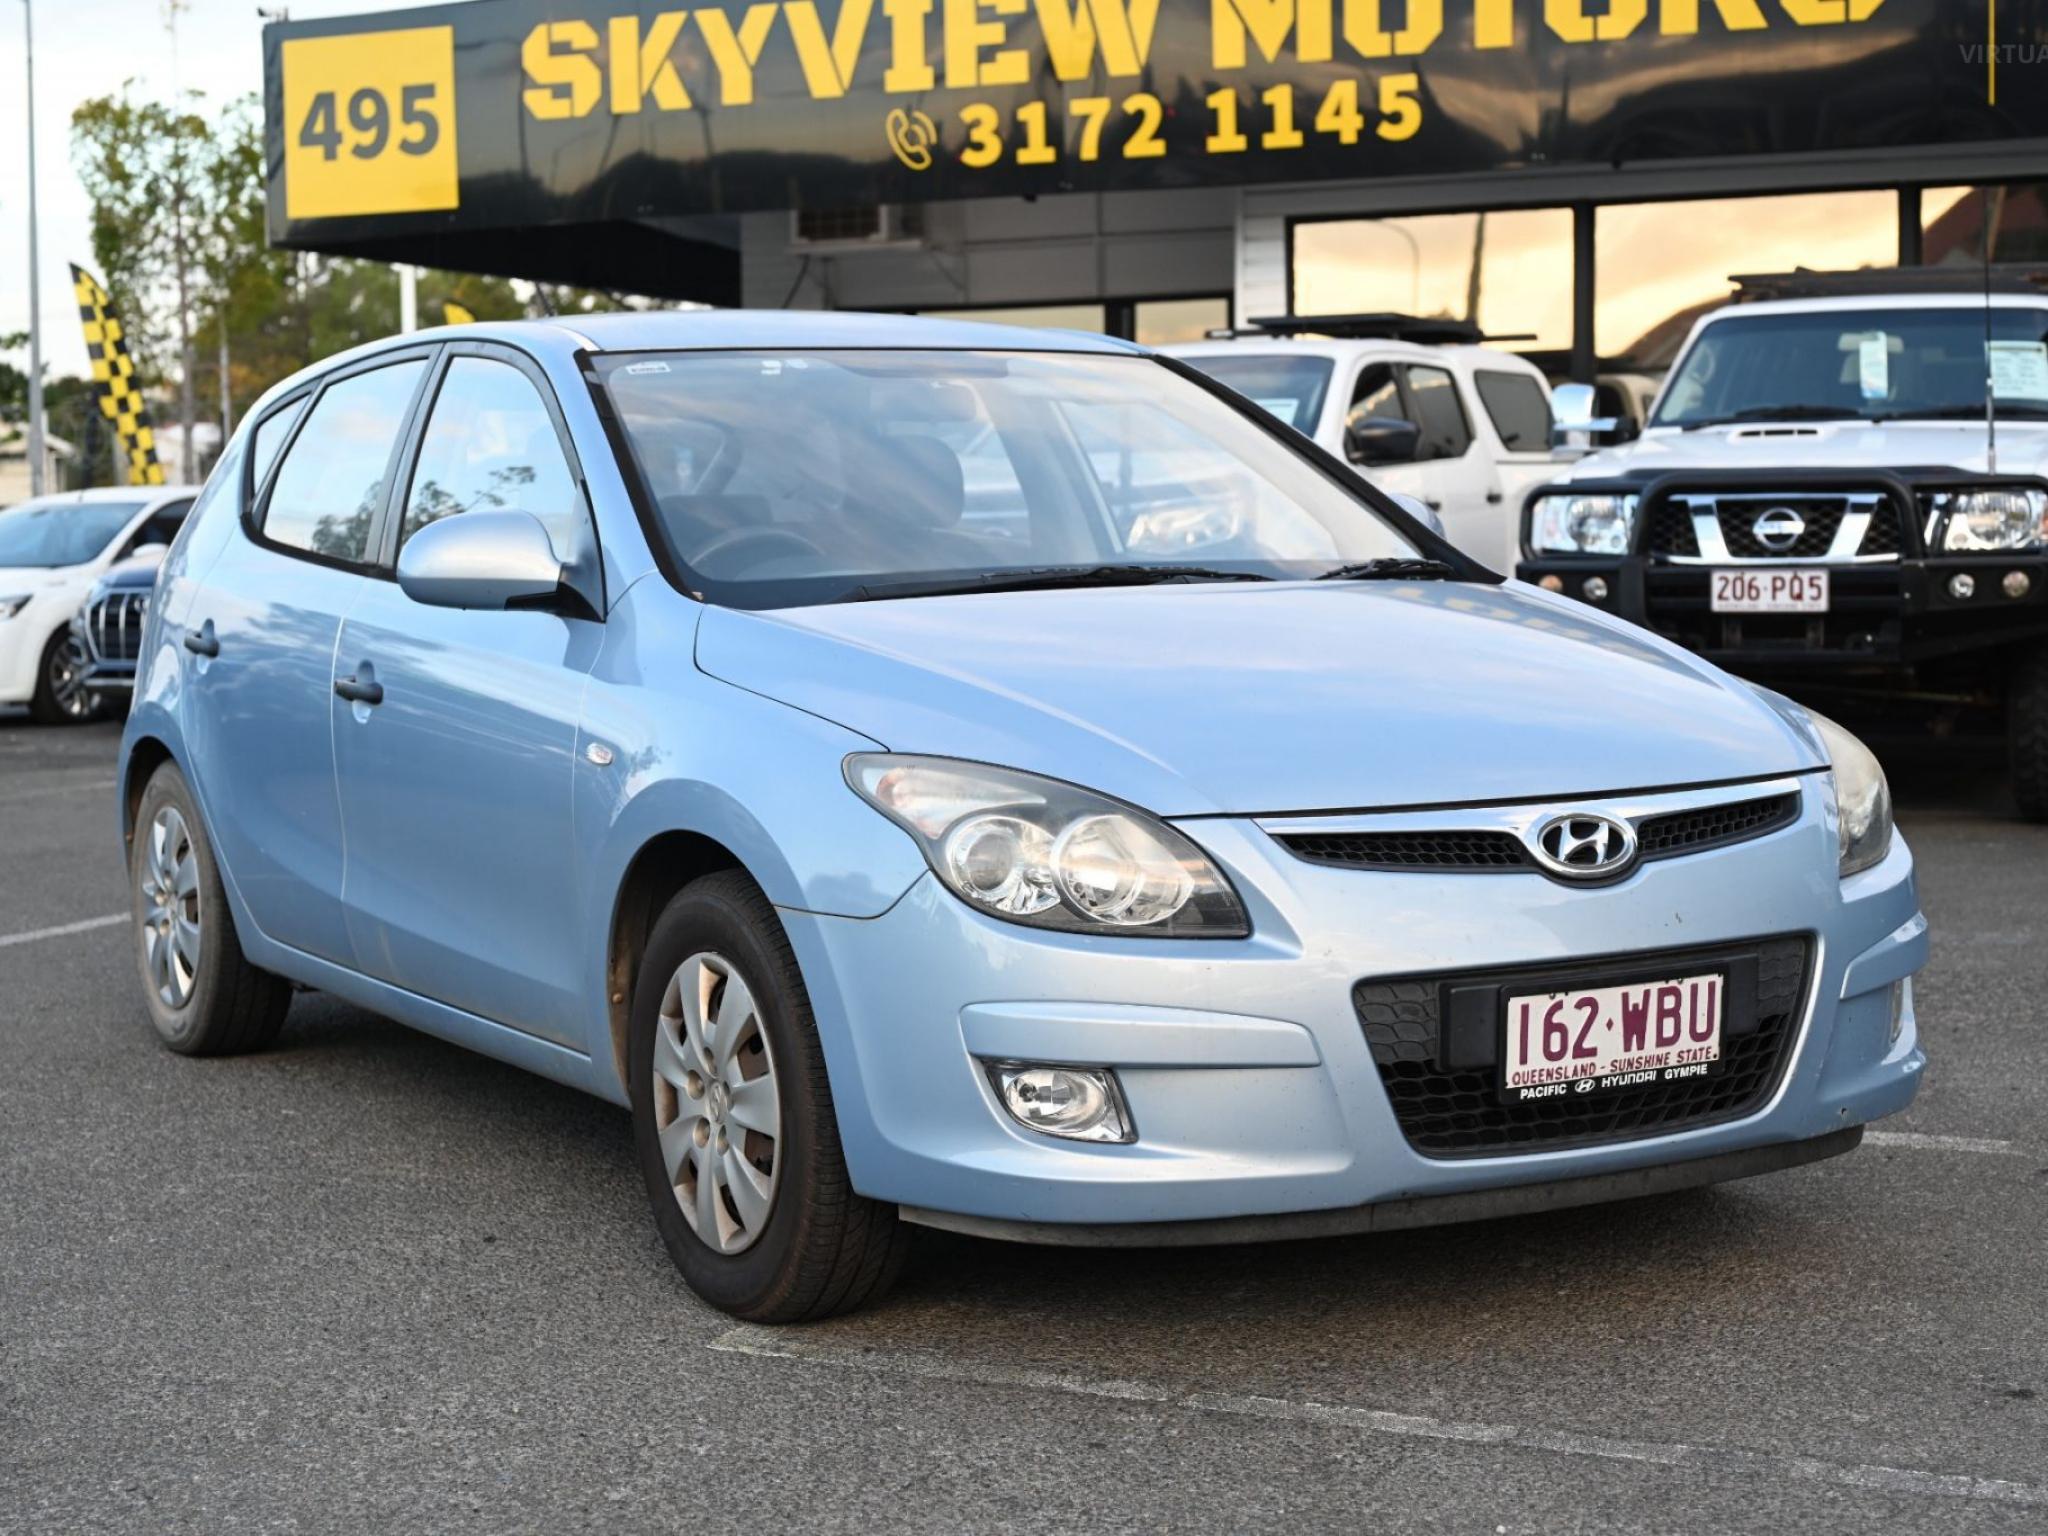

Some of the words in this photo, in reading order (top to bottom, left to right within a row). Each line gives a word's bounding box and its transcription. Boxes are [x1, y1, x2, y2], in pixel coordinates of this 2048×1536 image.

[522, 0, 1161, 120] SKYVIEW
[299, 83, 439, 161] 495
[959, 94, 1166, 167] 3172
[1206, 73, 1422, 154] 1145
[1519, 997, 1599, 1066] 162
[1621, 981, 1716, 1053] WBU
[1512, 1062, 1596, 1086] QUEENSLAND
[1610, 1052, 1671, 1073] SUNSHINE
[1677, 1046, 1712, 1063] STATE
[1520, 1083, 1567, 1100] PACIFIC
[1601, 1070, 1657, 1087] HYUNDAI
[1664, 1063, 1708, 1080] GYMPIE
